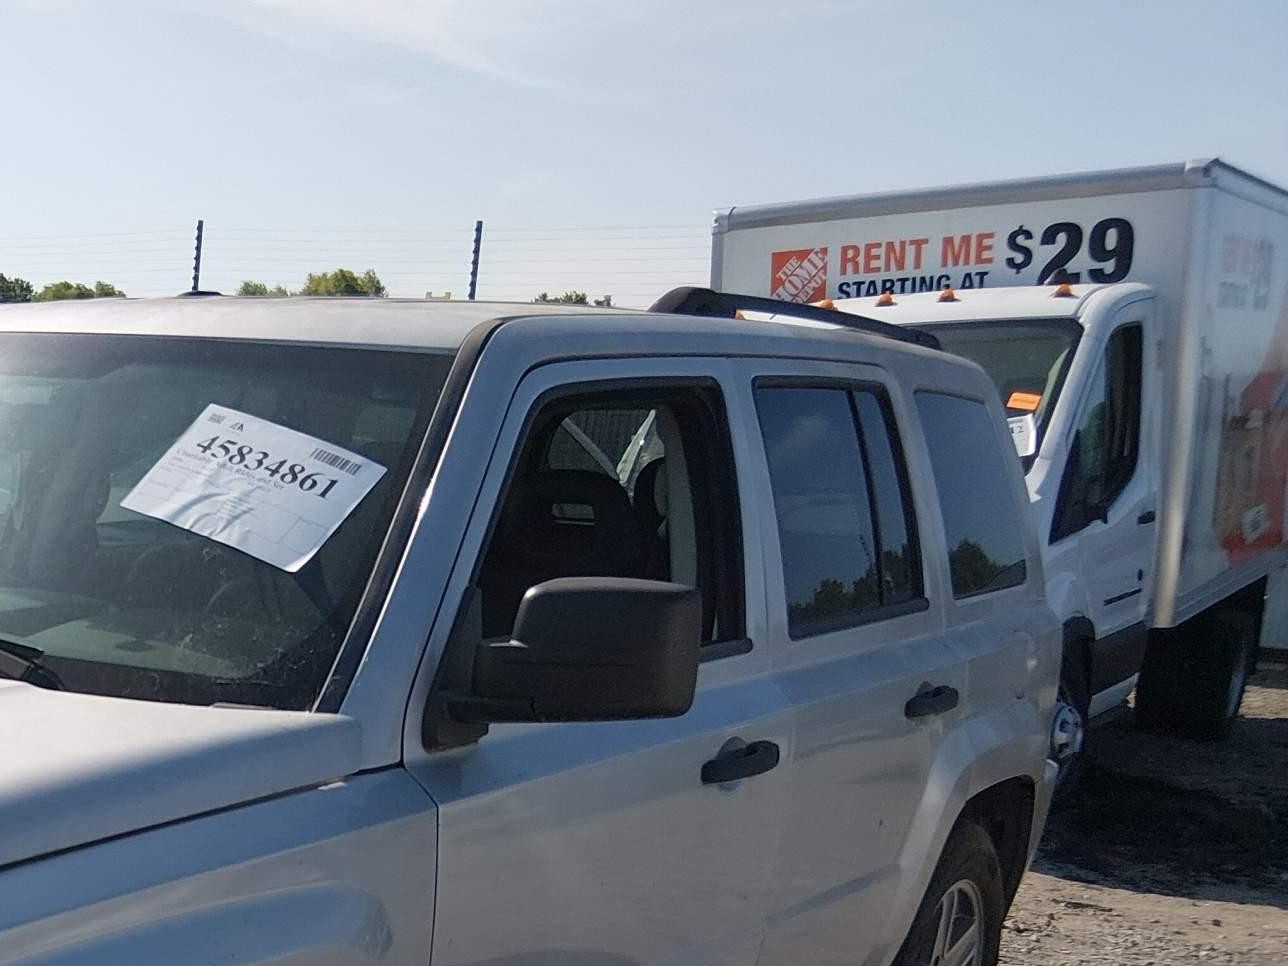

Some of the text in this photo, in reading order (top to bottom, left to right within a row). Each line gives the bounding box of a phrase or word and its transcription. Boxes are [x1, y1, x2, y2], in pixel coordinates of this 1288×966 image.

[776, 255, 801, 280] THE
[839, 217, 1135, 286] RENT ME $29
[837, 271, 989, 299] STARTING AT
[196, 435, 339, 500] 45834861
